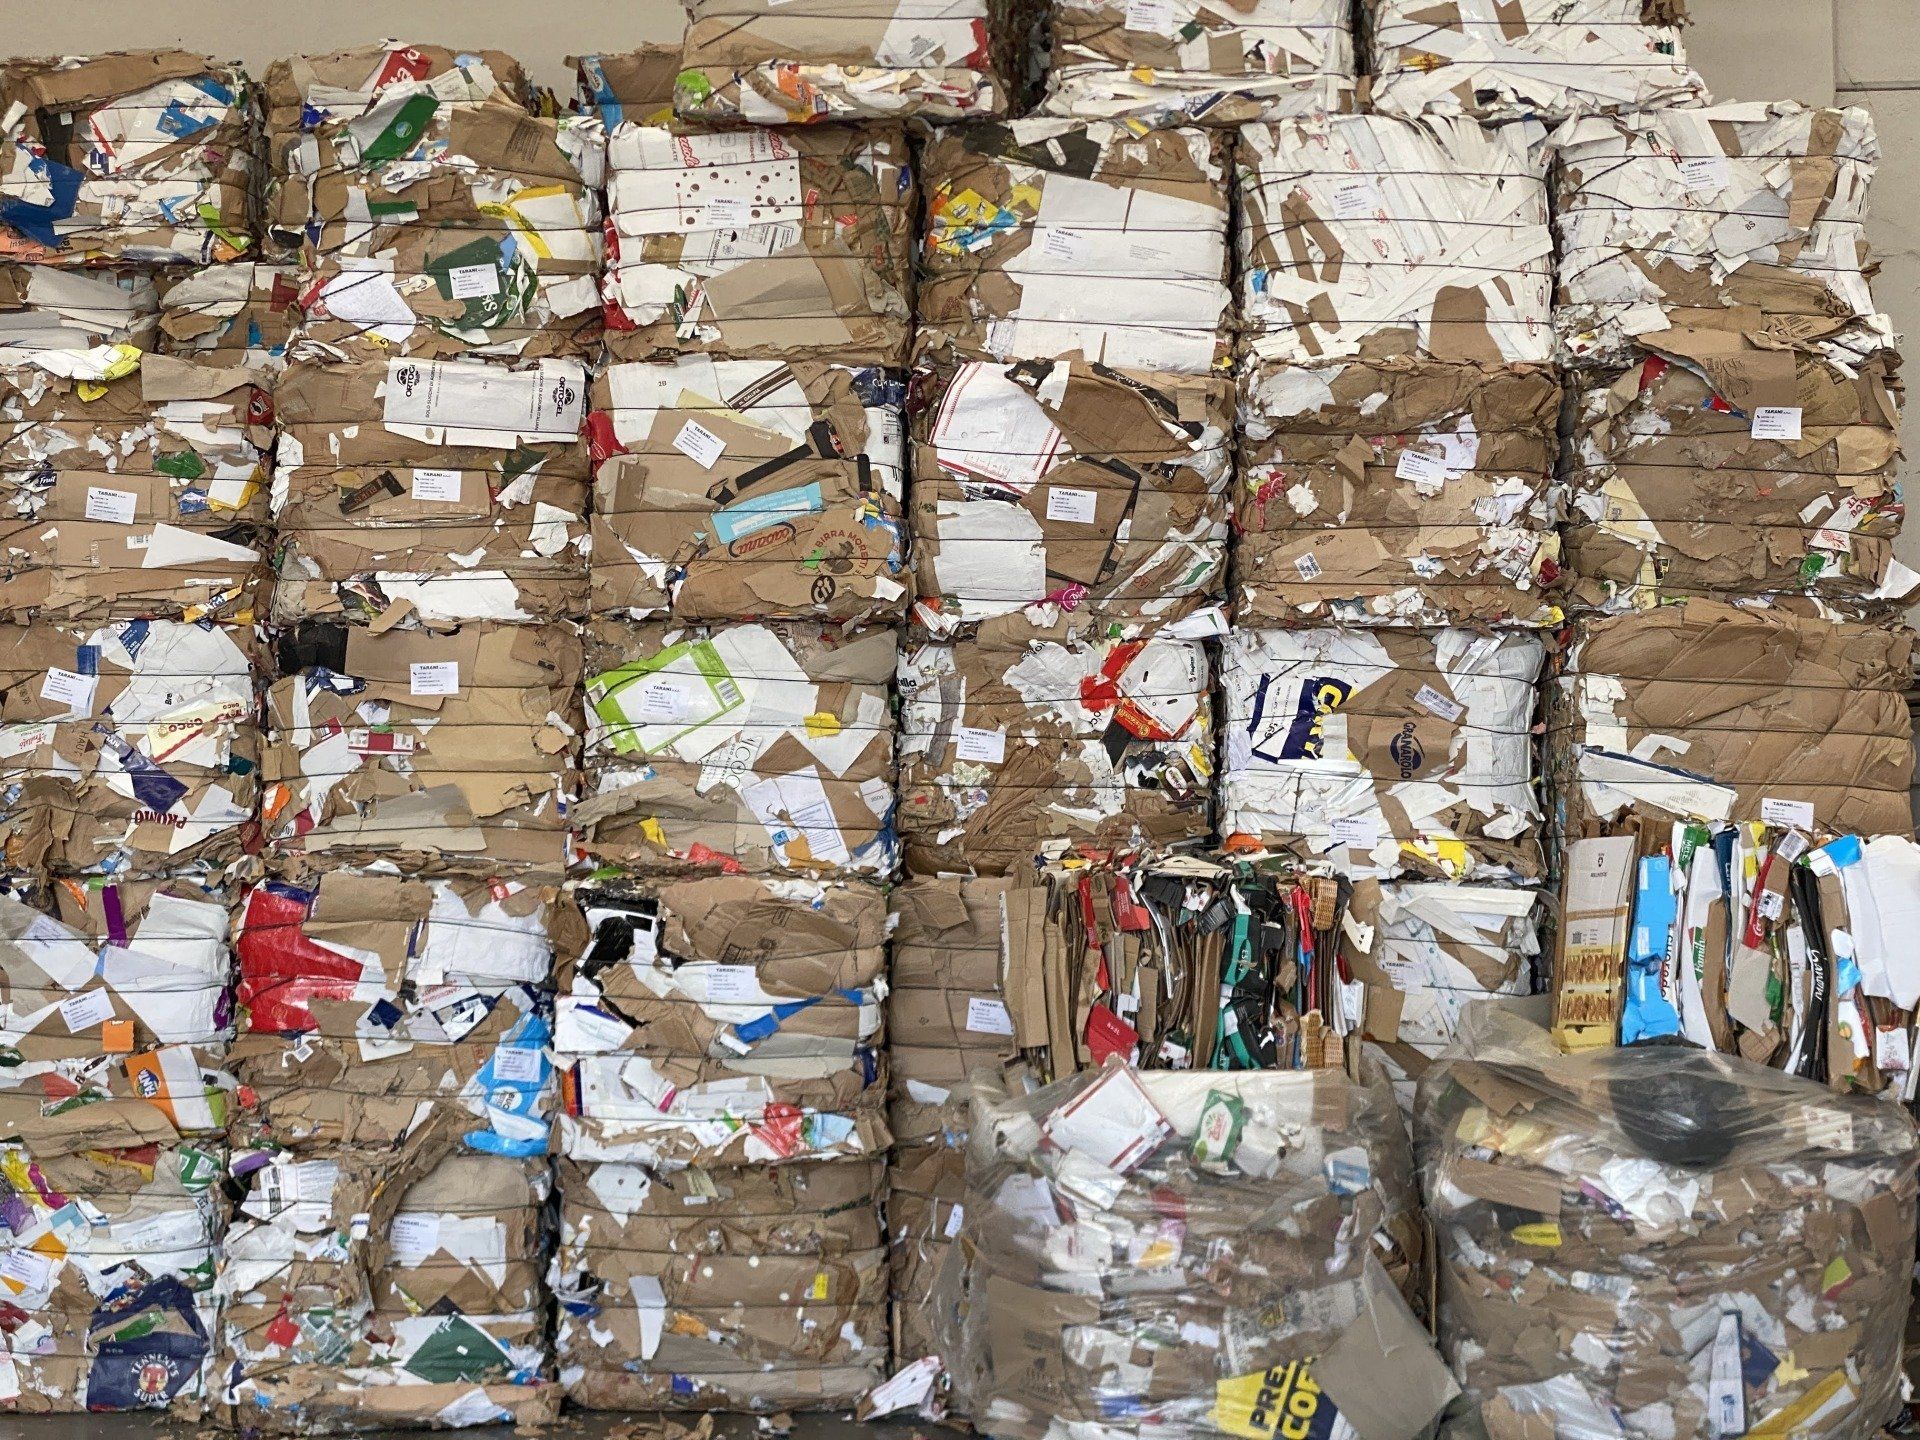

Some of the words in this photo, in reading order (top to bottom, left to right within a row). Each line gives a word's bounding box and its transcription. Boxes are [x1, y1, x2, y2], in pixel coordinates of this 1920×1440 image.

[458, 267, 478, 275] TARANI
[555, 376, 566, 418] ORTOGEL
[694, 426, 712, 440] TARANI
[1411, 452, 1431, 462] TARANI
[98, 490, 118, 498] TARANI
[815, 530, 845, 548] BIRRA
[814, 577, 833, 603] Cif
[58, 671, 76, 680] TARANI
[968, 729, 988, 737] TARANI
[1401, 722, 1417, 779] GRANAROLO
[69, 995, 88, 1007] TARANI
